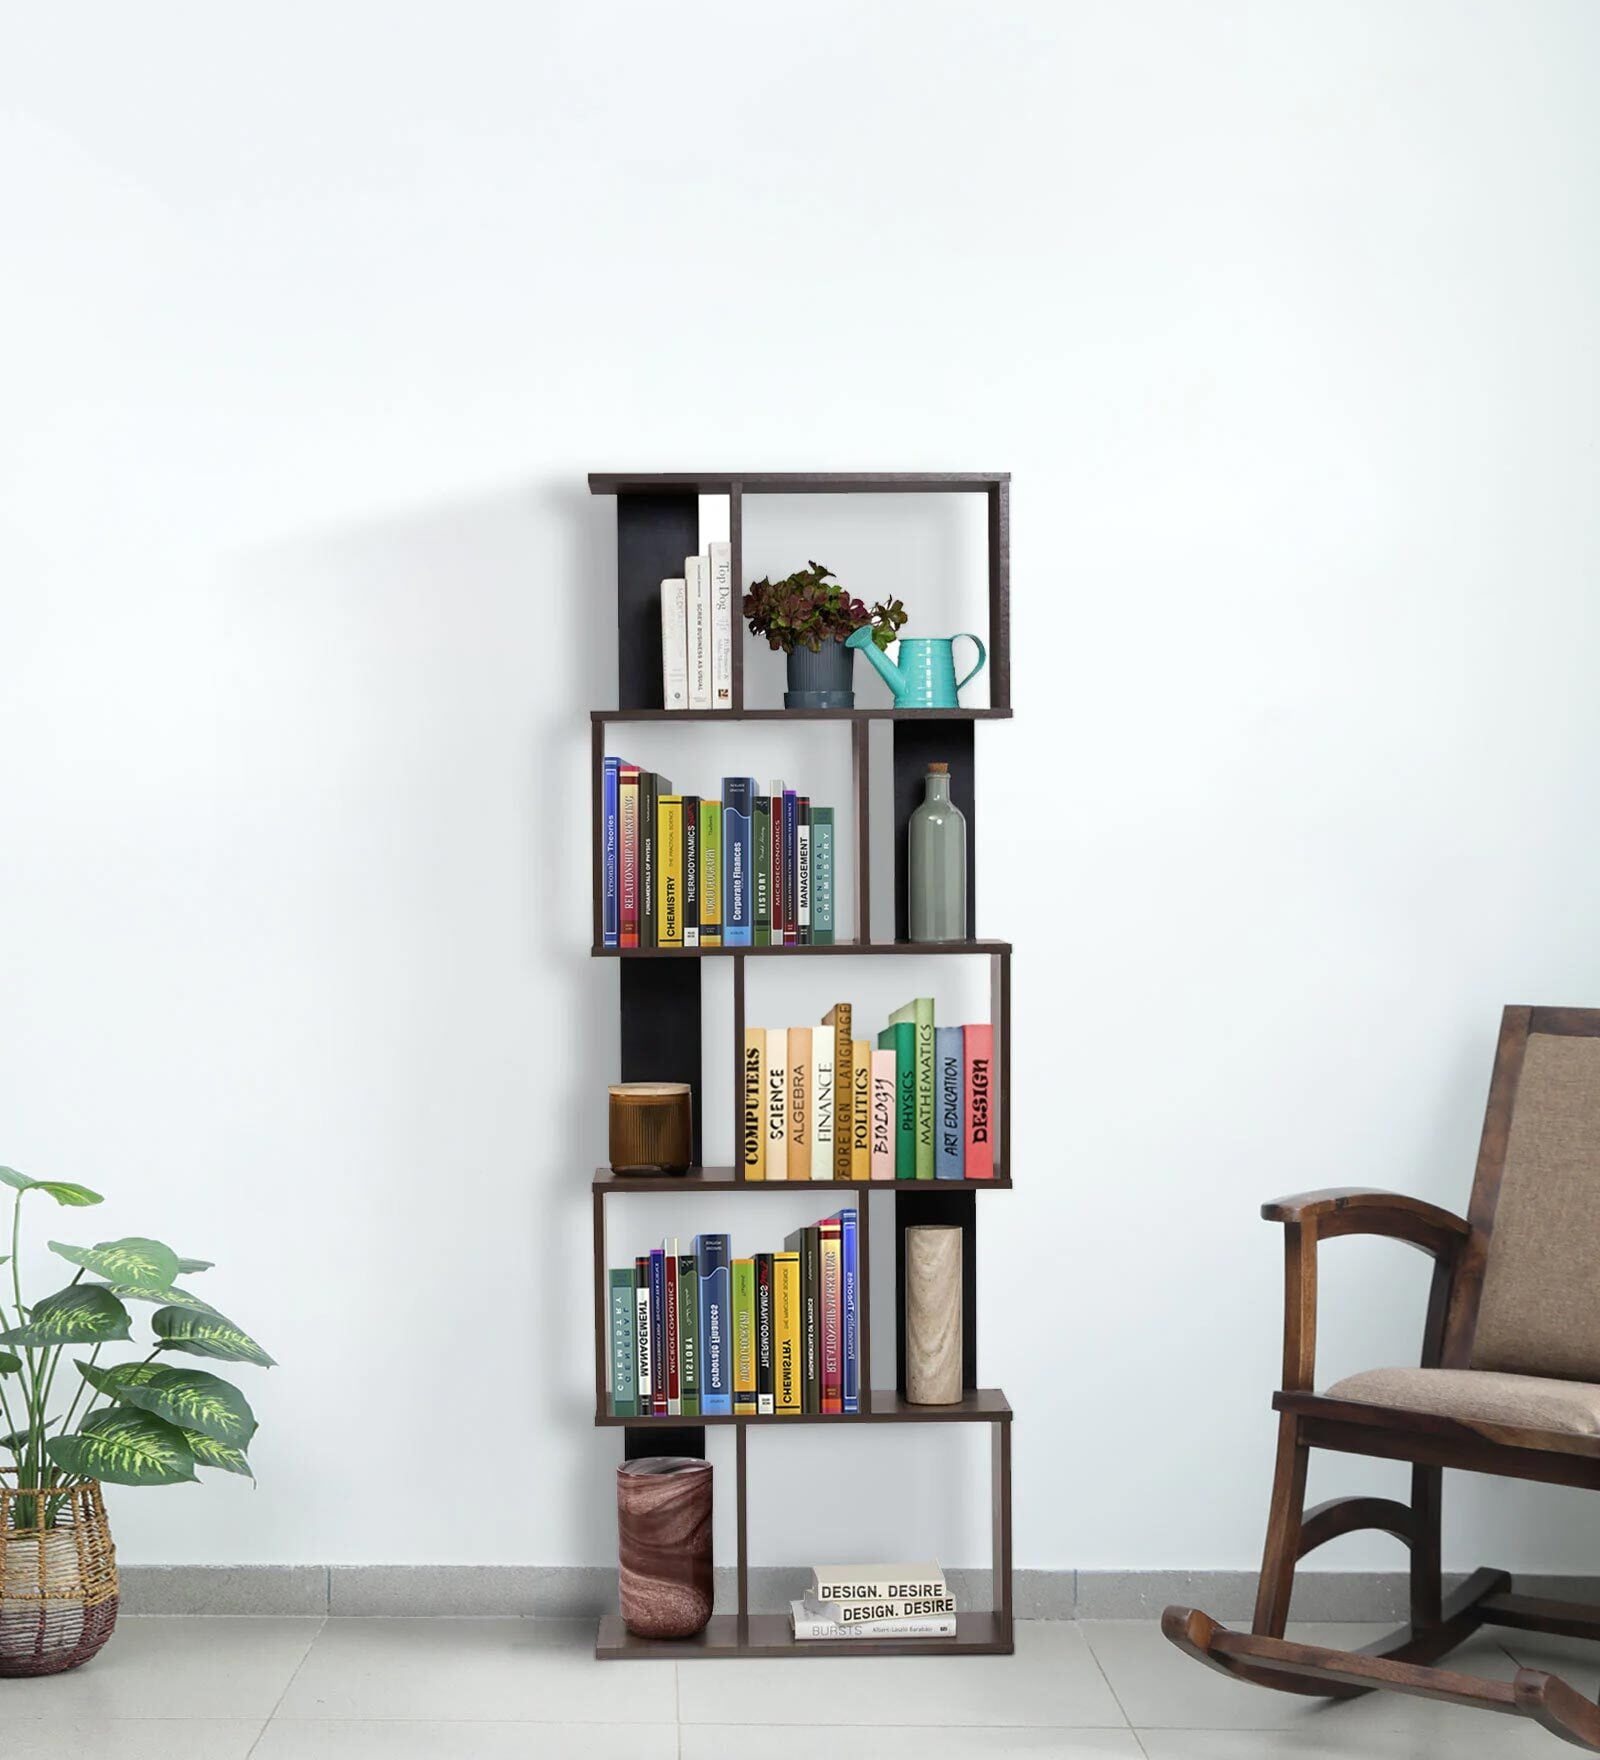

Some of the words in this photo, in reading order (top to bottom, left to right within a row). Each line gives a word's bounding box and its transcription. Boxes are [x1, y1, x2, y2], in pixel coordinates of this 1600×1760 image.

[716, 562, 729, 583] Top
[717, 586, 730, 610] Dog
[625, 796, 634, 848] MARKETING
[625, 850, 634, 909] RELATIONSHIP
[733, 842, 741, 878] Finances
[666, 876, 675, 937] CHEMISTRY
[733, 880, 742, 920] Corporate
[839, 1004, 851, 1089] LANGUAGE
[745, 1047, 760, 1166] COMPUTERS
[770, 1069, 784, 1140] SCIENCE
[793, 1065, 804, 1145] ALGEBRA
[818, 1062, 832, 1142] FINANCE
[855, 1068, 868, 1150] POLITICS
[902, 1071, 913, 1131] PHYSICS
[920, 1024, 931, 1145] MATHEMATICS
[944, 1057, 957, 1128] EDUCATION
[972, 1059, 988, 1144] DESIGN
[838, 1102, 851, 1180] FOREIGN
[874, 1078, 894, 1154] BIOLOGY
[944, 1131, 957, 1156] ART
[822, 1586, 882, 1598] DESIGN.
[888, 1584, 942, 1597] DESIRE
[844, 1605, 898, 1621] DESIGN.
[904, 1599, 953, 1615] DESIRE
[812, 1626, 862, 1636] BURSTS
